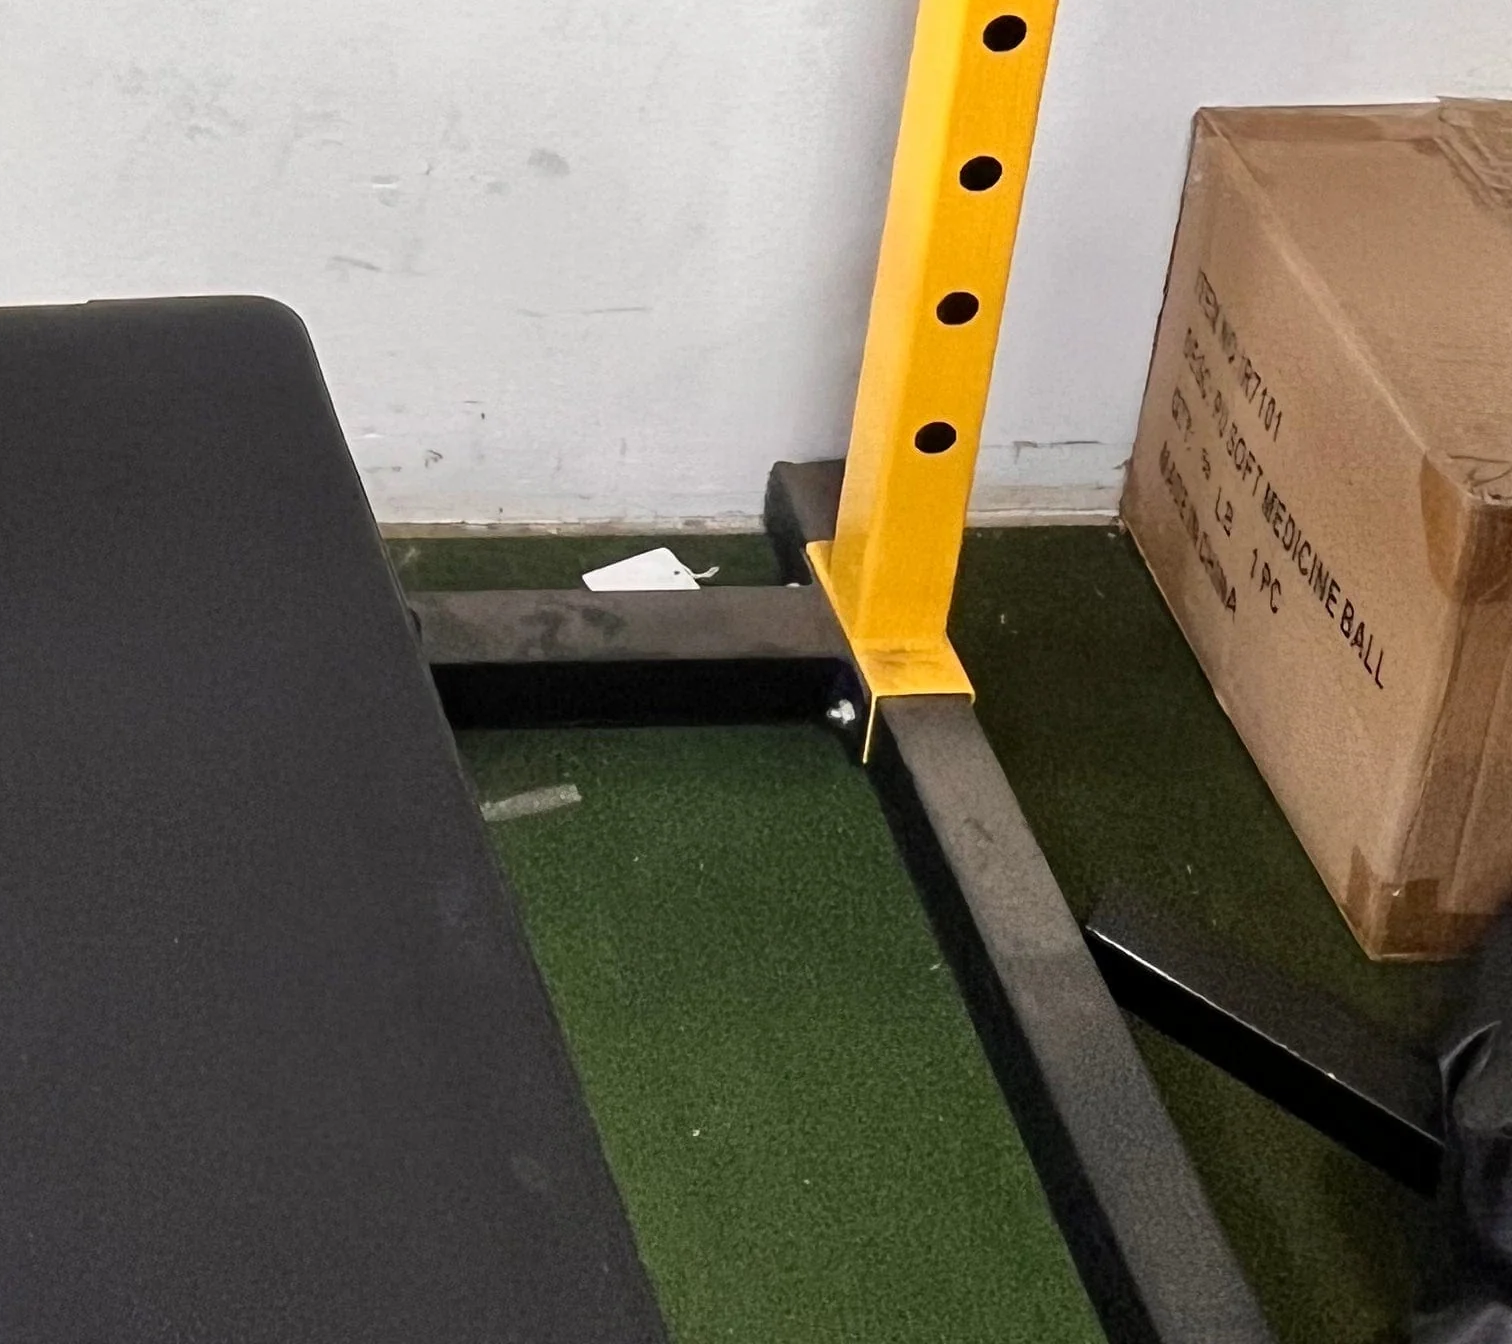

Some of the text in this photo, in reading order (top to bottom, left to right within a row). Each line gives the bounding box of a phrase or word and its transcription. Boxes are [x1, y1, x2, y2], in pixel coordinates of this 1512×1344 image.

[1226, 422, 1263, 496] SOFT
[1262, 482, 1341, 619] MEDICINE
[1340, 598, 1385, 690] BALL
